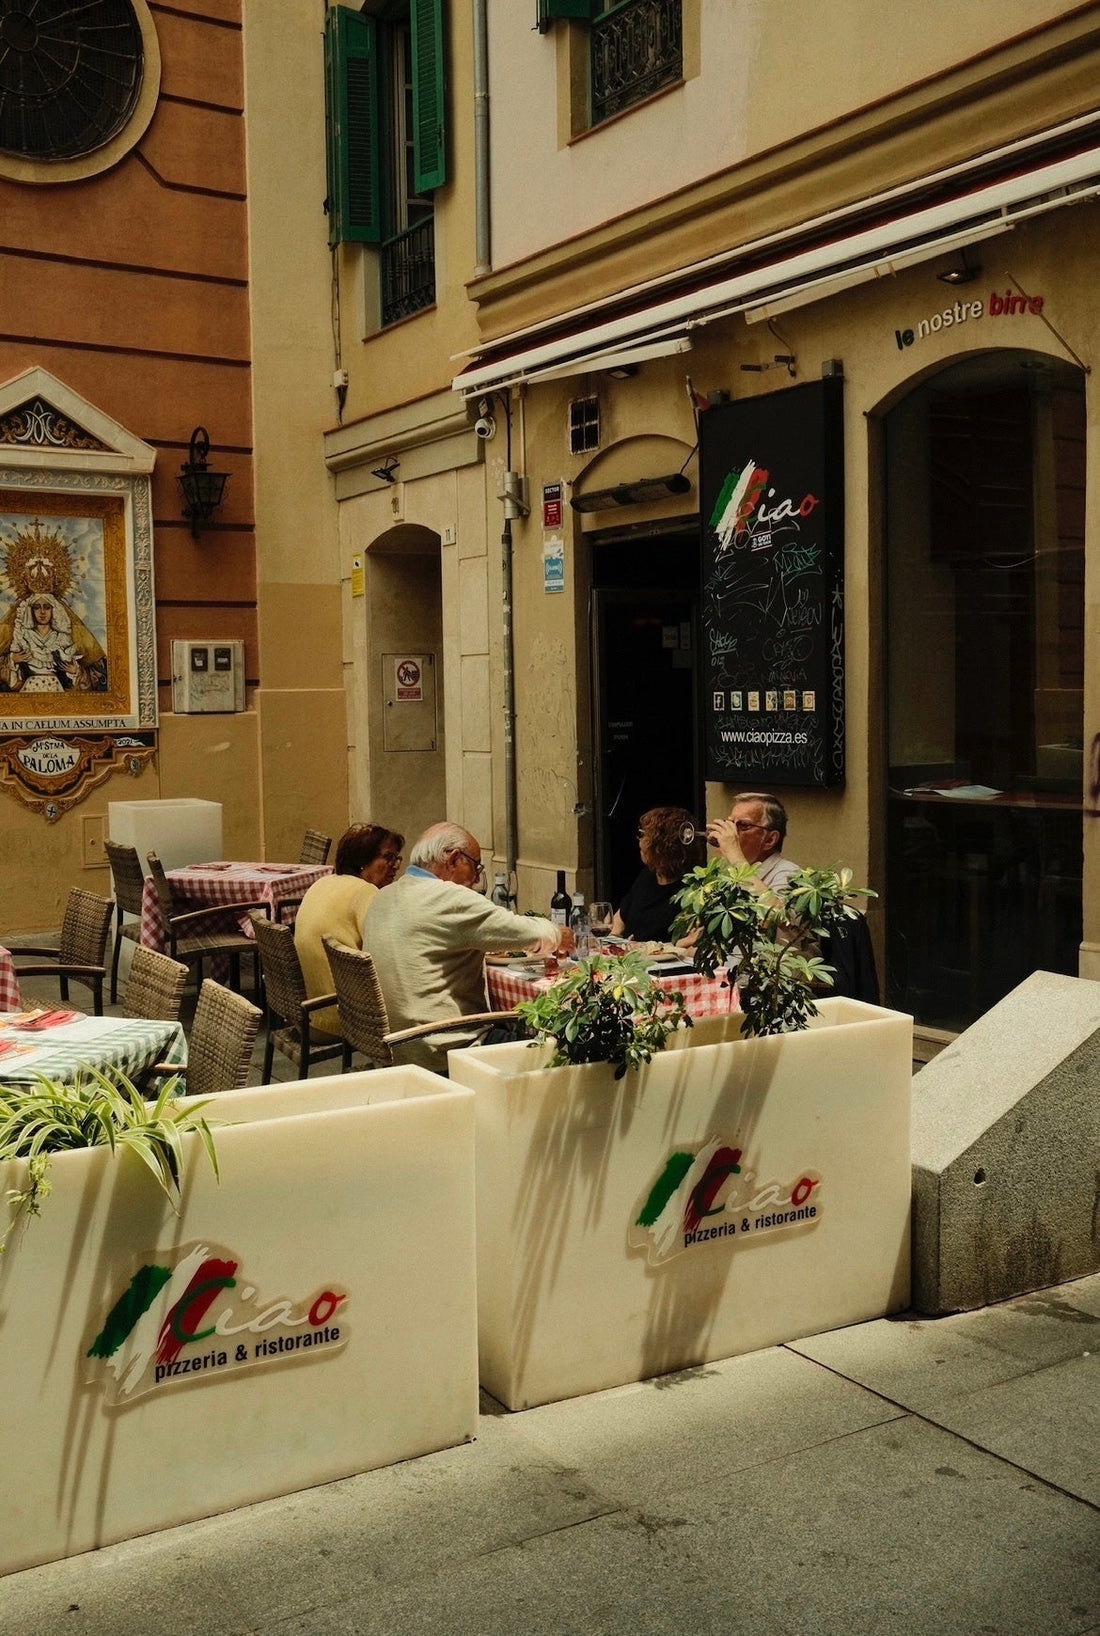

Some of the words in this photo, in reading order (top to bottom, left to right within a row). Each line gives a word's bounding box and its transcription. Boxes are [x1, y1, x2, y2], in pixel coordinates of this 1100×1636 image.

[895, 328, 915, 350] le
[918, 299, 984, 338] nostre
[989, 291, 1044, 315] birre
[11, 721, 23, 730] IN
[25, 720, 70, 730] CAELUM
[72, 719, 127, 729] ASSUMPTA
[720, 728, 808, 747] www.ciaopizza.es
[23, 755, 75, 773] PALOMA
[695, 1164, 820, 1217] Ciao
[684, 1222, 736, 1248] pizzeria
[740, 1218, 750, 1232] &
[755, 1205, 817, 1229] ristorante
[173, 1277, 347, 1343] Ciao
[154, 1350, 228, 1383] pizzeria
[234, 1344, 248, 1362] &
[255, 1326, 341, 1358] ristorante
